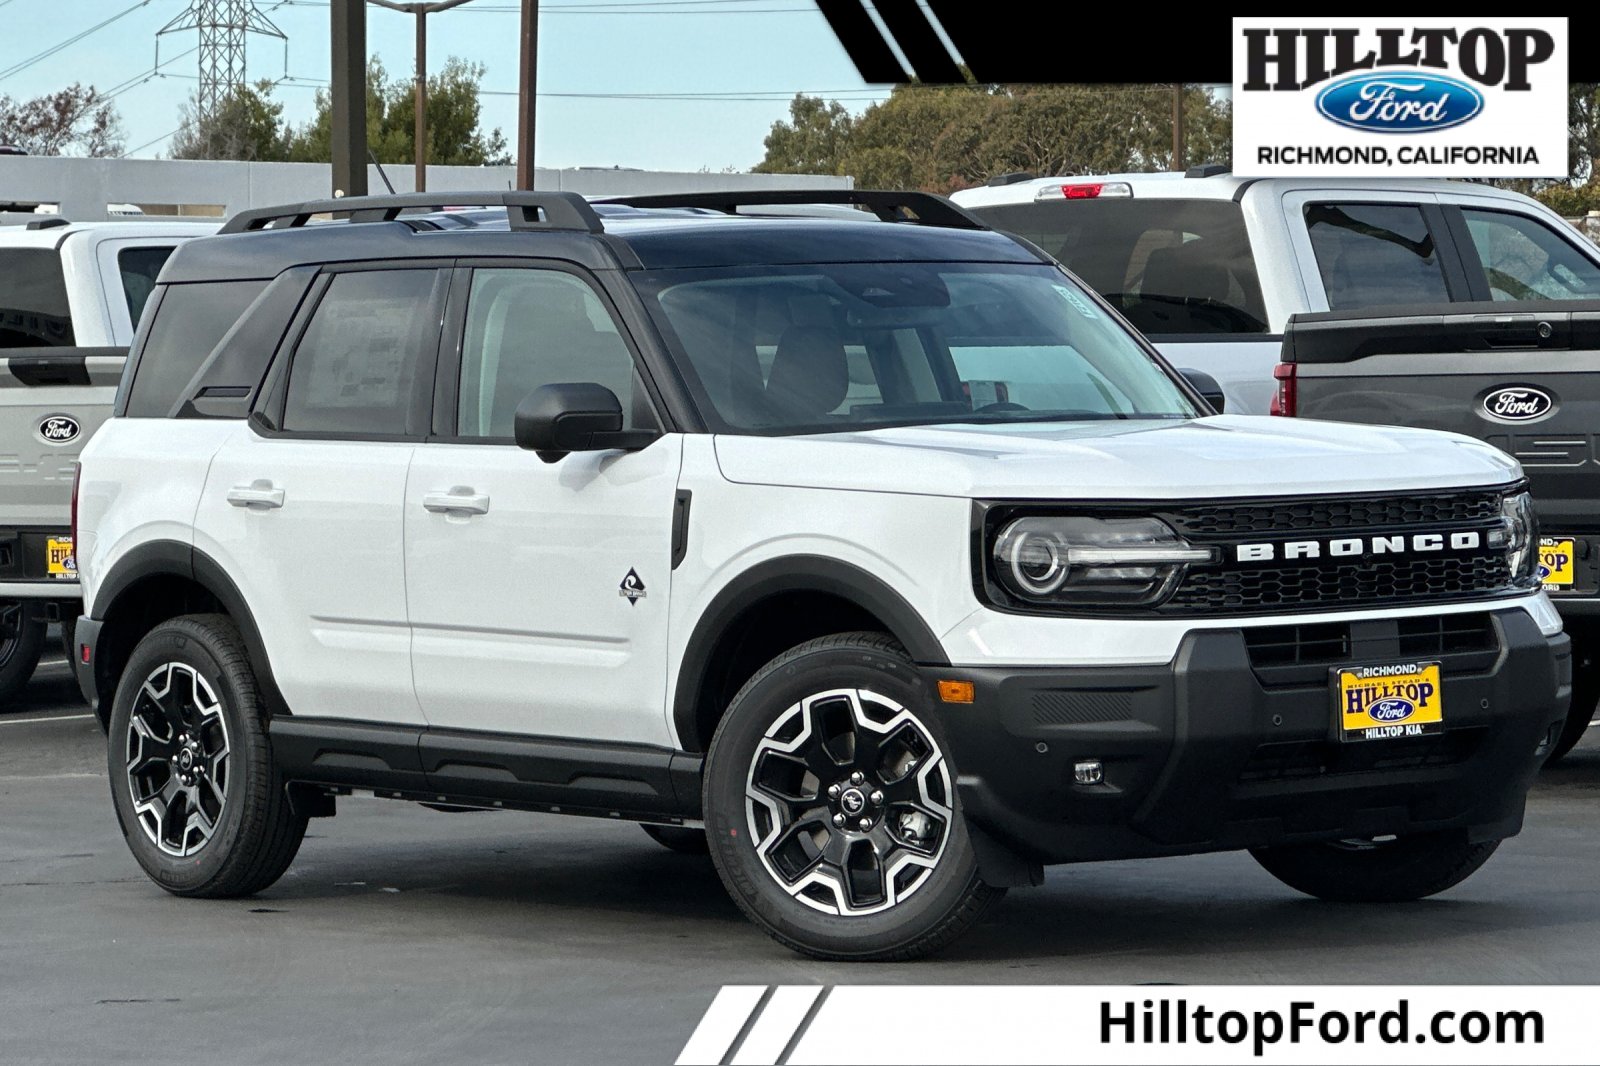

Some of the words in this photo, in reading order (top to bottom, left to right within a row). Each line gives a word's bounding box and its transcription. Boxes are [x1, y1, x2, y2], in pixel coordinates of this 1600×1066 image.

[1494, 391, 1539, 414] Ford
[44, 419, 73, 438] Ford
[1236, 532, 1480, 562] BRONCO
[1363, 664, 1417, 678] RICHMOND
[1345, 682, 1434, 714] HILLTOP
[1377, 701, 1407, 719] Ford
[1365, 726, 1404, 739] HILLTOP
[1405, 724, 1422, 736] KIA
